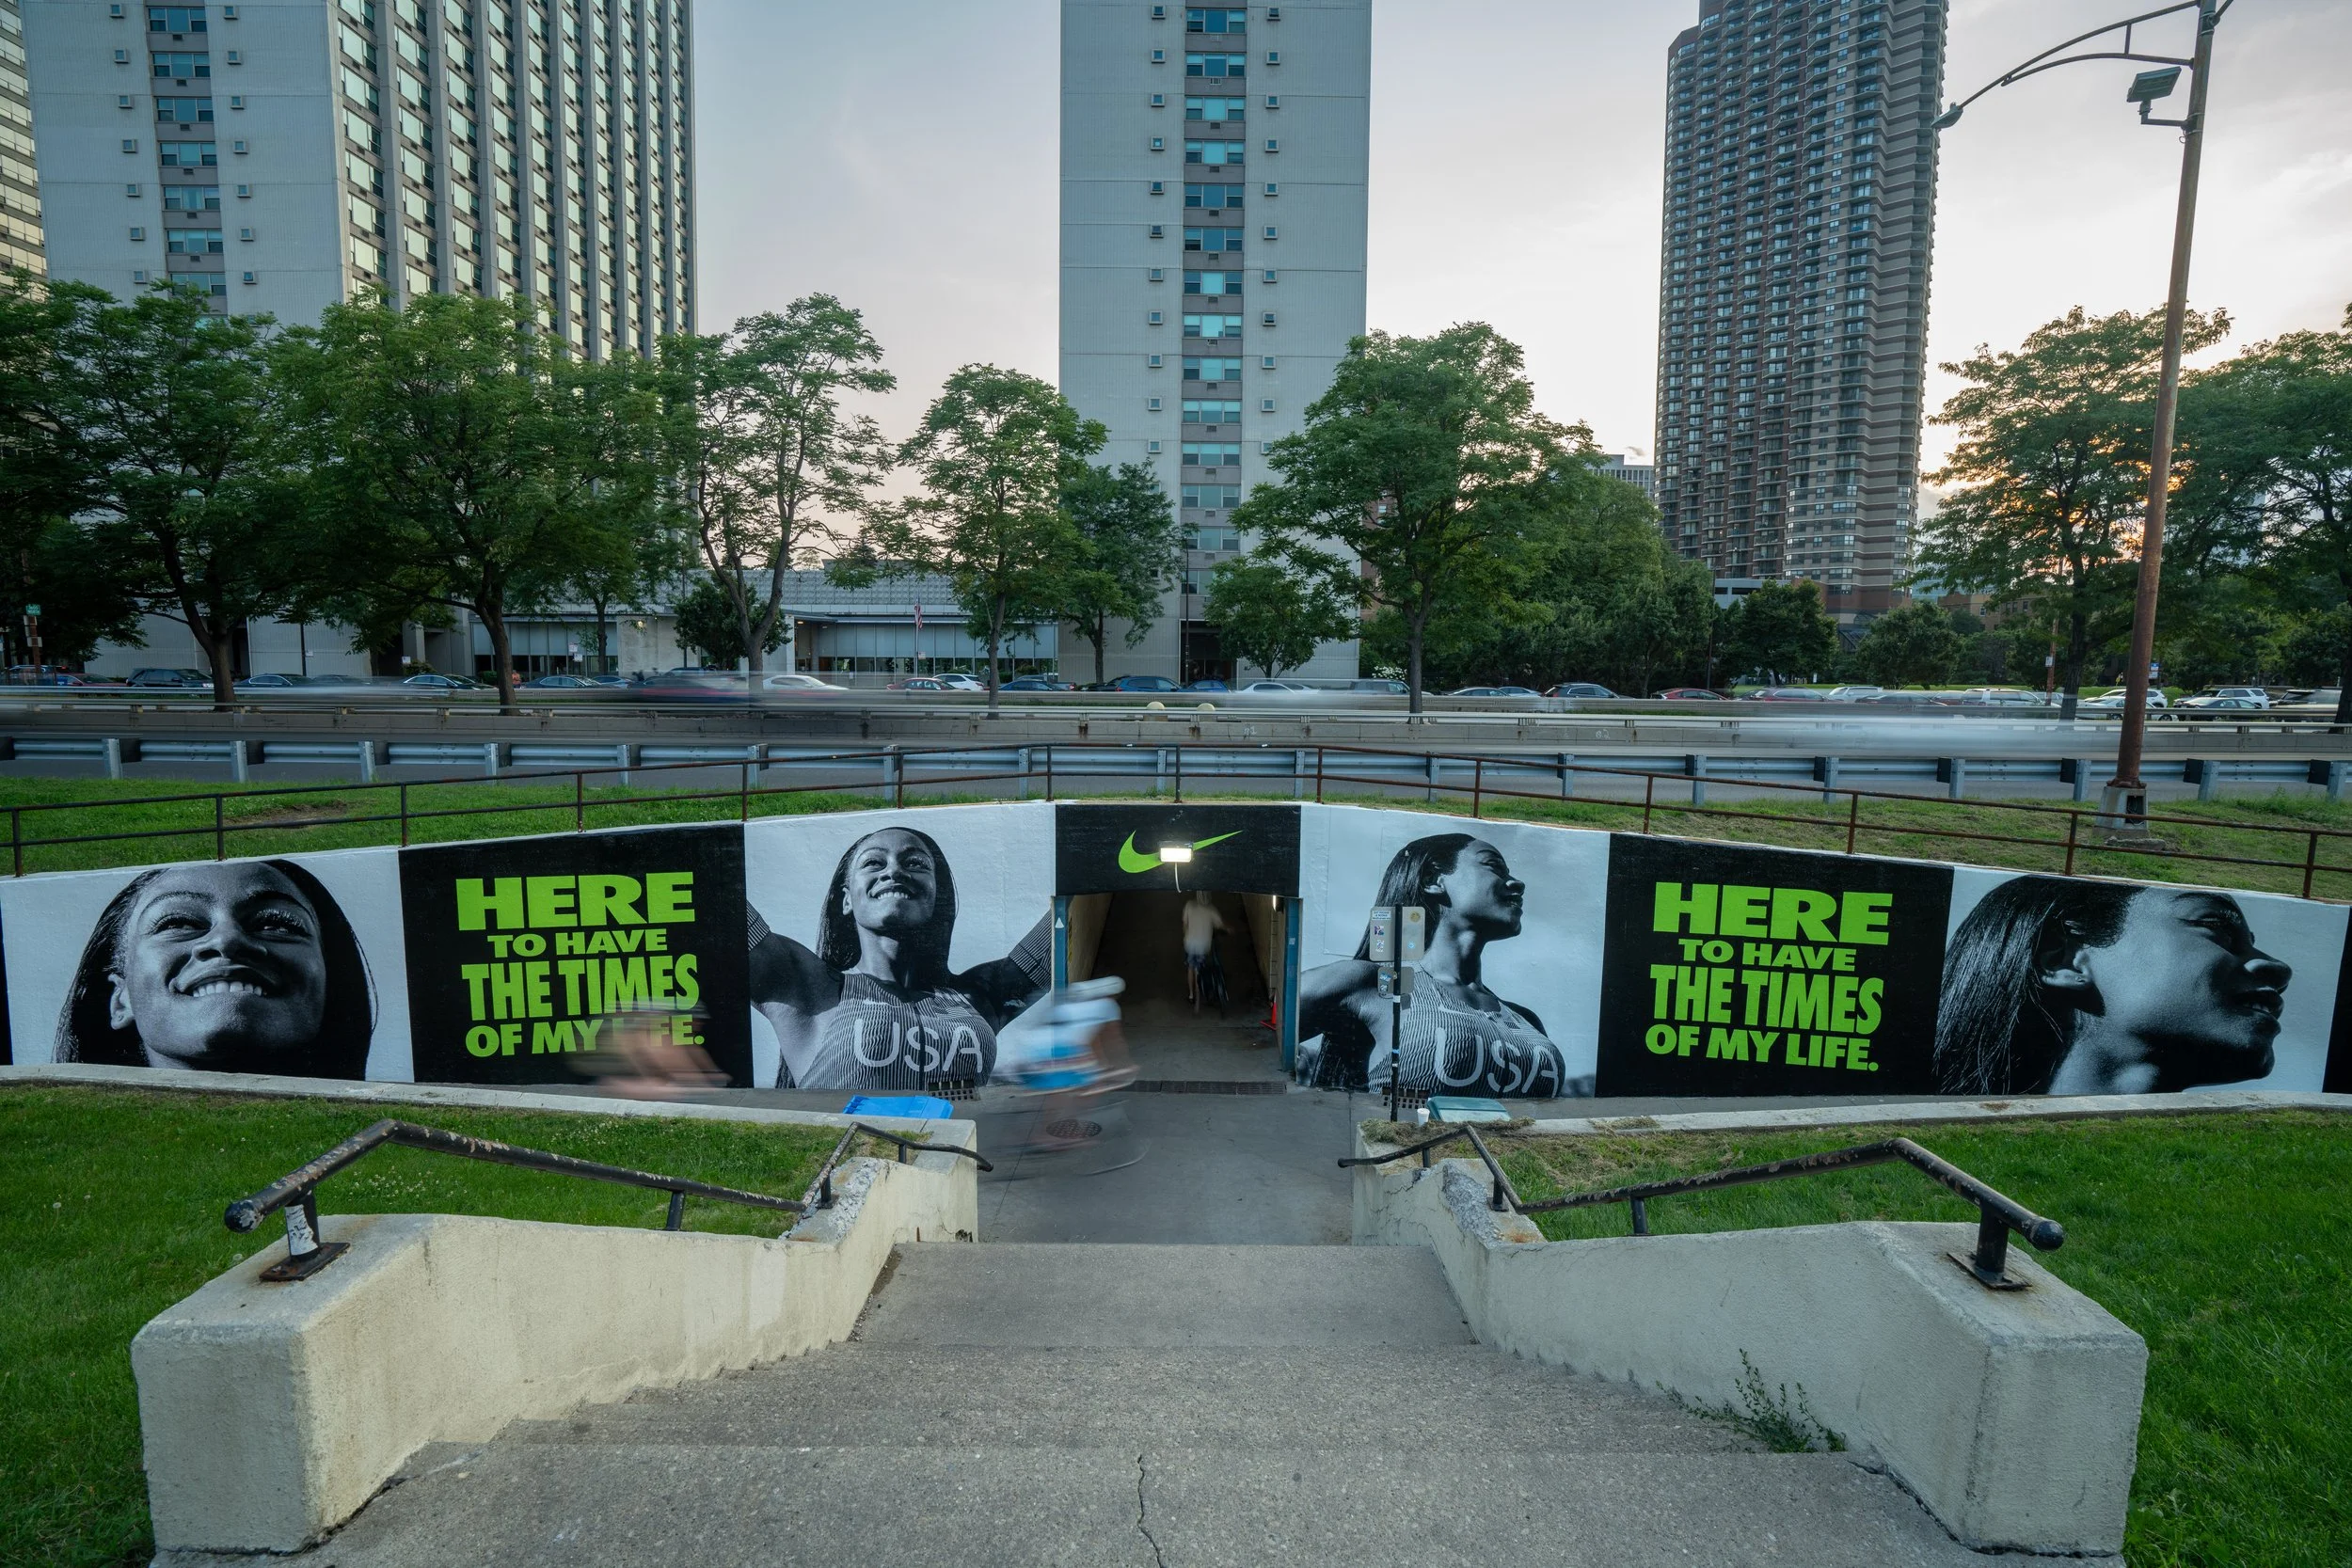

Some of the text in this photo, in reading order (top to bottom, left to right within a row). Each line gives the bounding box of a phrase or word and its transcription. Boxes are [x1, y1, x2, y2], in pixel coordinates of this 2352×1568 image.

[456, 871, 696, 931] HERE
[1653, 881, 1894, 945] HERE
[487, 927, 668, 958] TO HAVE
[1678, 938, 1857, 972] TO HAVE
[461, 953, 700, 1021] THE TIMES
[1650, 963, 1884, 1035] THE TIMES
[465, 1013, 705, 1057] OF MY FE.
[853, 1018, 983, 1073] USA
[1435, 1026, 1559, 1099] USA
[1645, 1023, 1879, 1072] OF MY LIFE.
